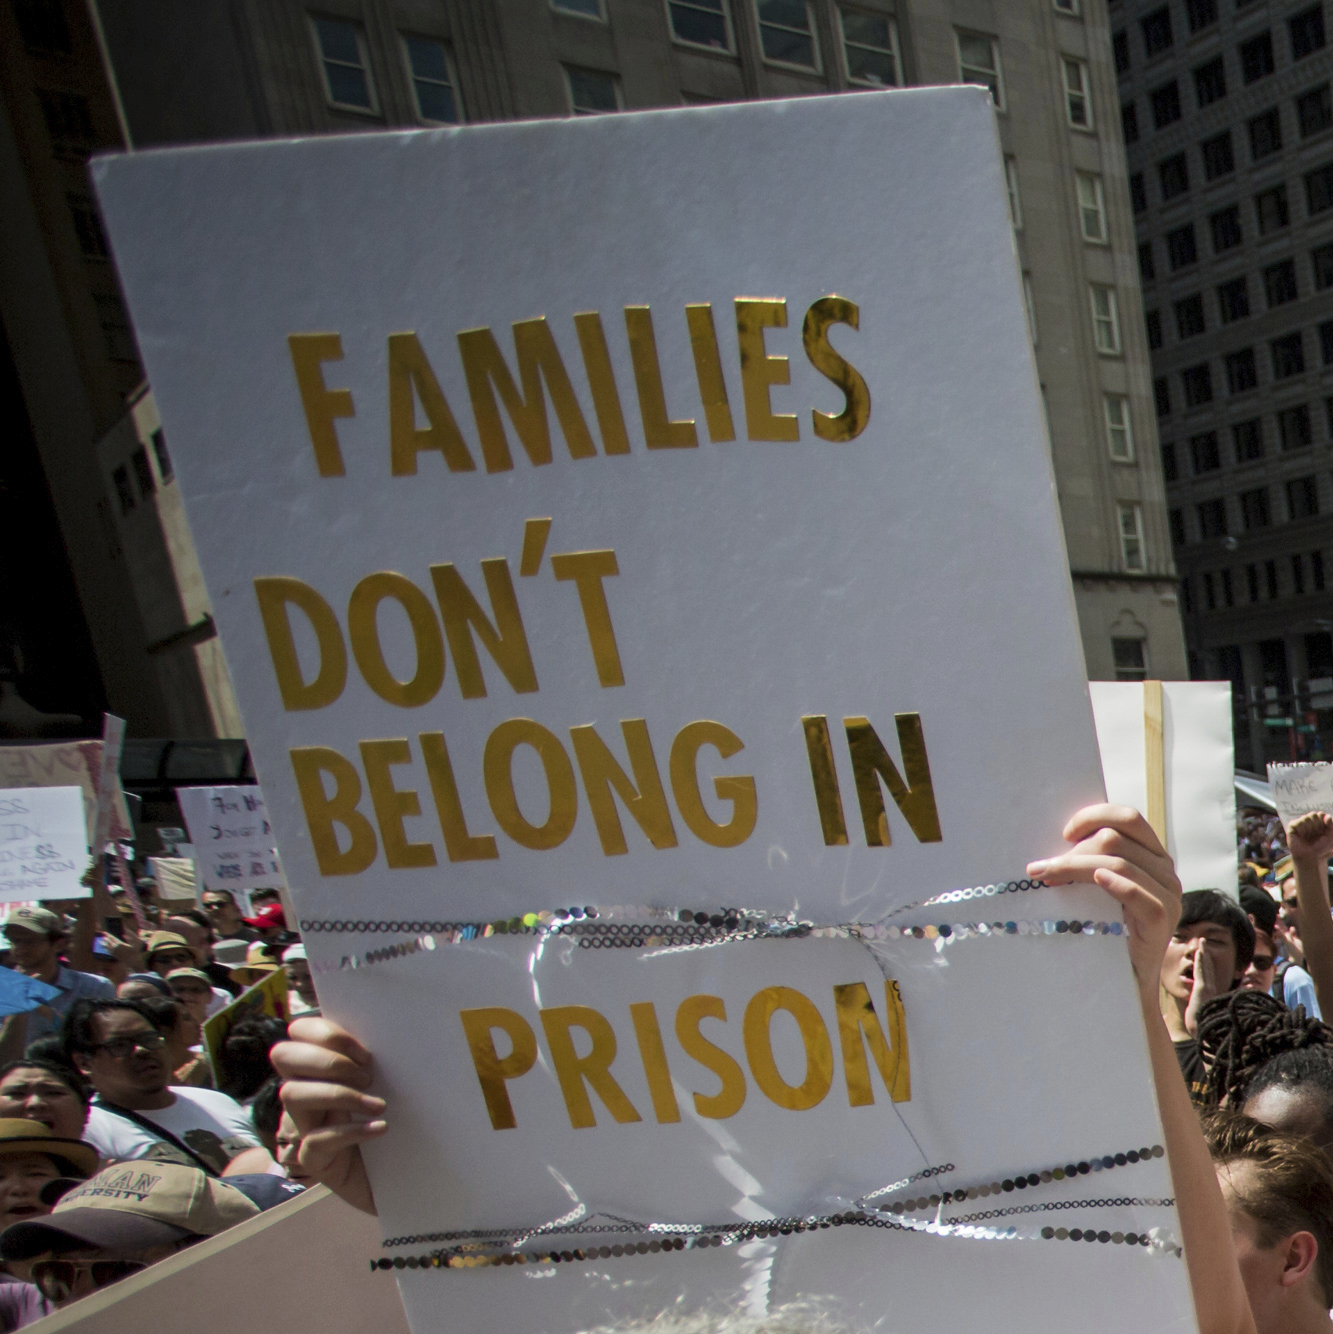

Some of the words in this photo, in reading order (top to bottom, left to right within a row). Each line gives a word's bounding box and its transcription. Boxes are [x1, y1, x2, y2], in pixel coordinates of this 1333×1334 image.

[287, 294, 873, 478] FAMILIES
[253, 517, 626, 711] DON'T
[289, 718, 759, 876] BELONG
[800, 711, 943, 847] IN
[1274, 778, 1317, 796] MAKE
[460, 978, 912, 1131] PRISON
